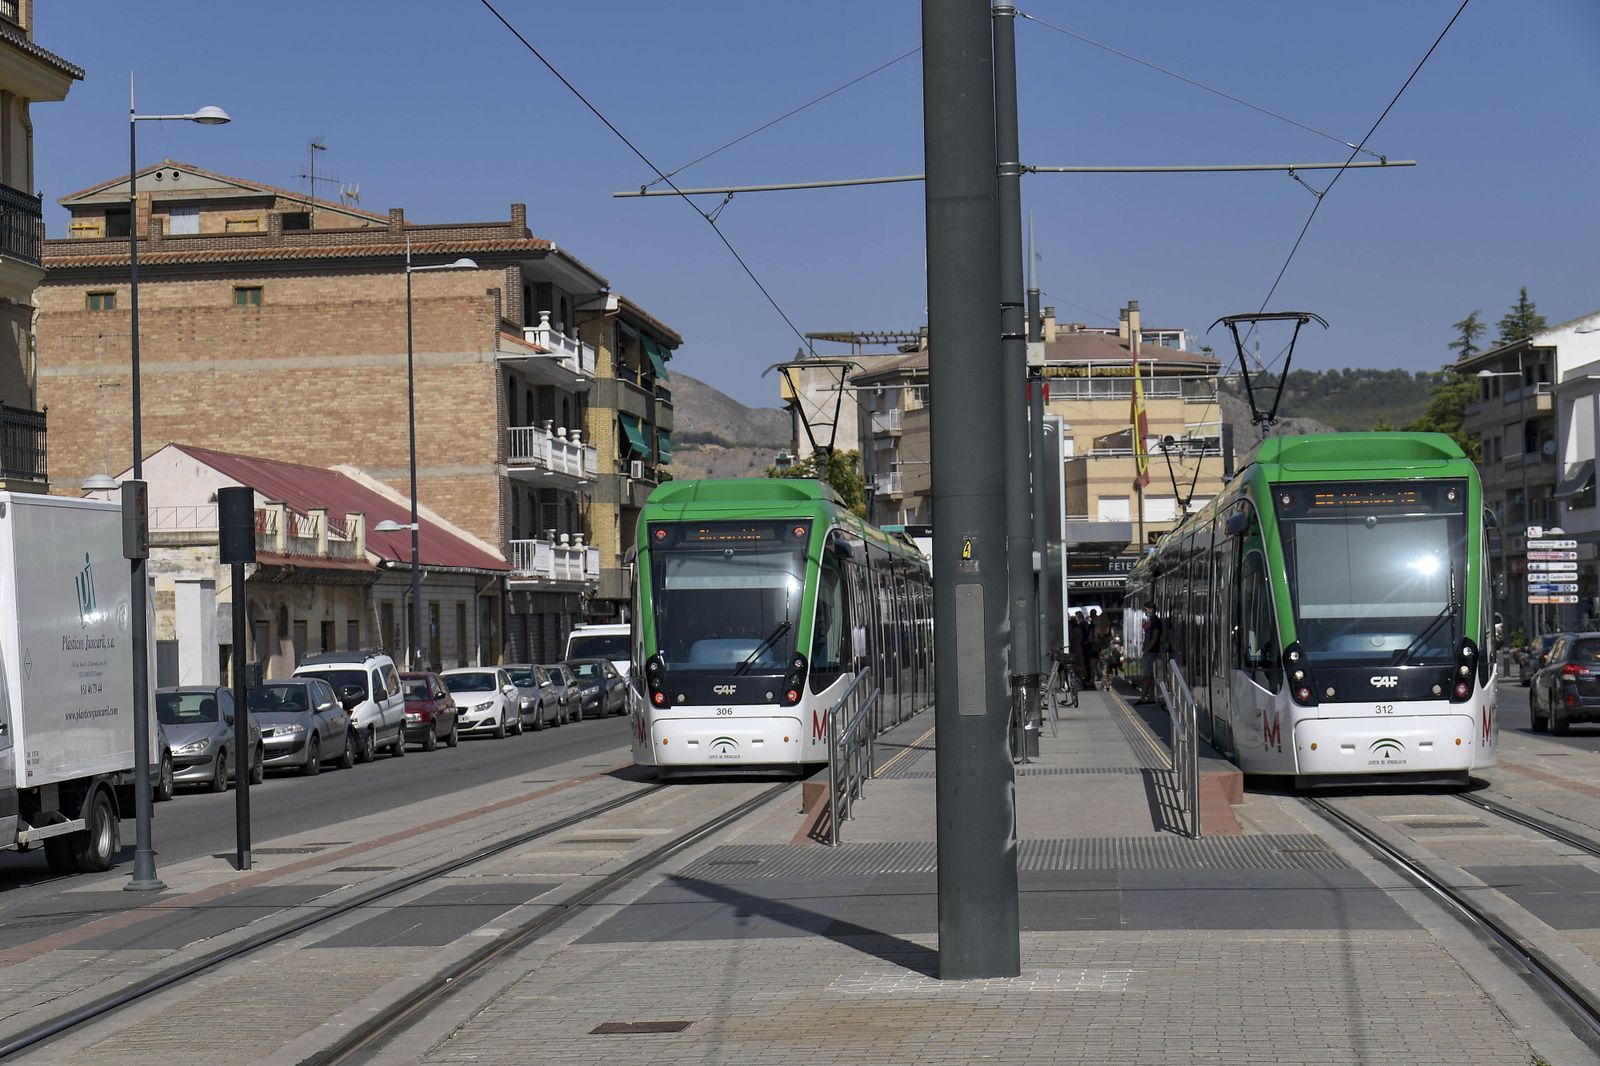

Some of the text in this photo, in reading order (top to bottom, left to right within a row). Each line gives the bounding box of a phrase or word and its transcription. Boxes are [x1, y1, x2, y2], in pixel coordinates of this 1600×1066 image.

[62, 634, 85, 651] Plásticos
[1370, 676, 1398, 688] CAF
[713, 685, 737, 695] CAF
[1375, 705, 1394, 714] 312
[812, 708, 828, 746] M
